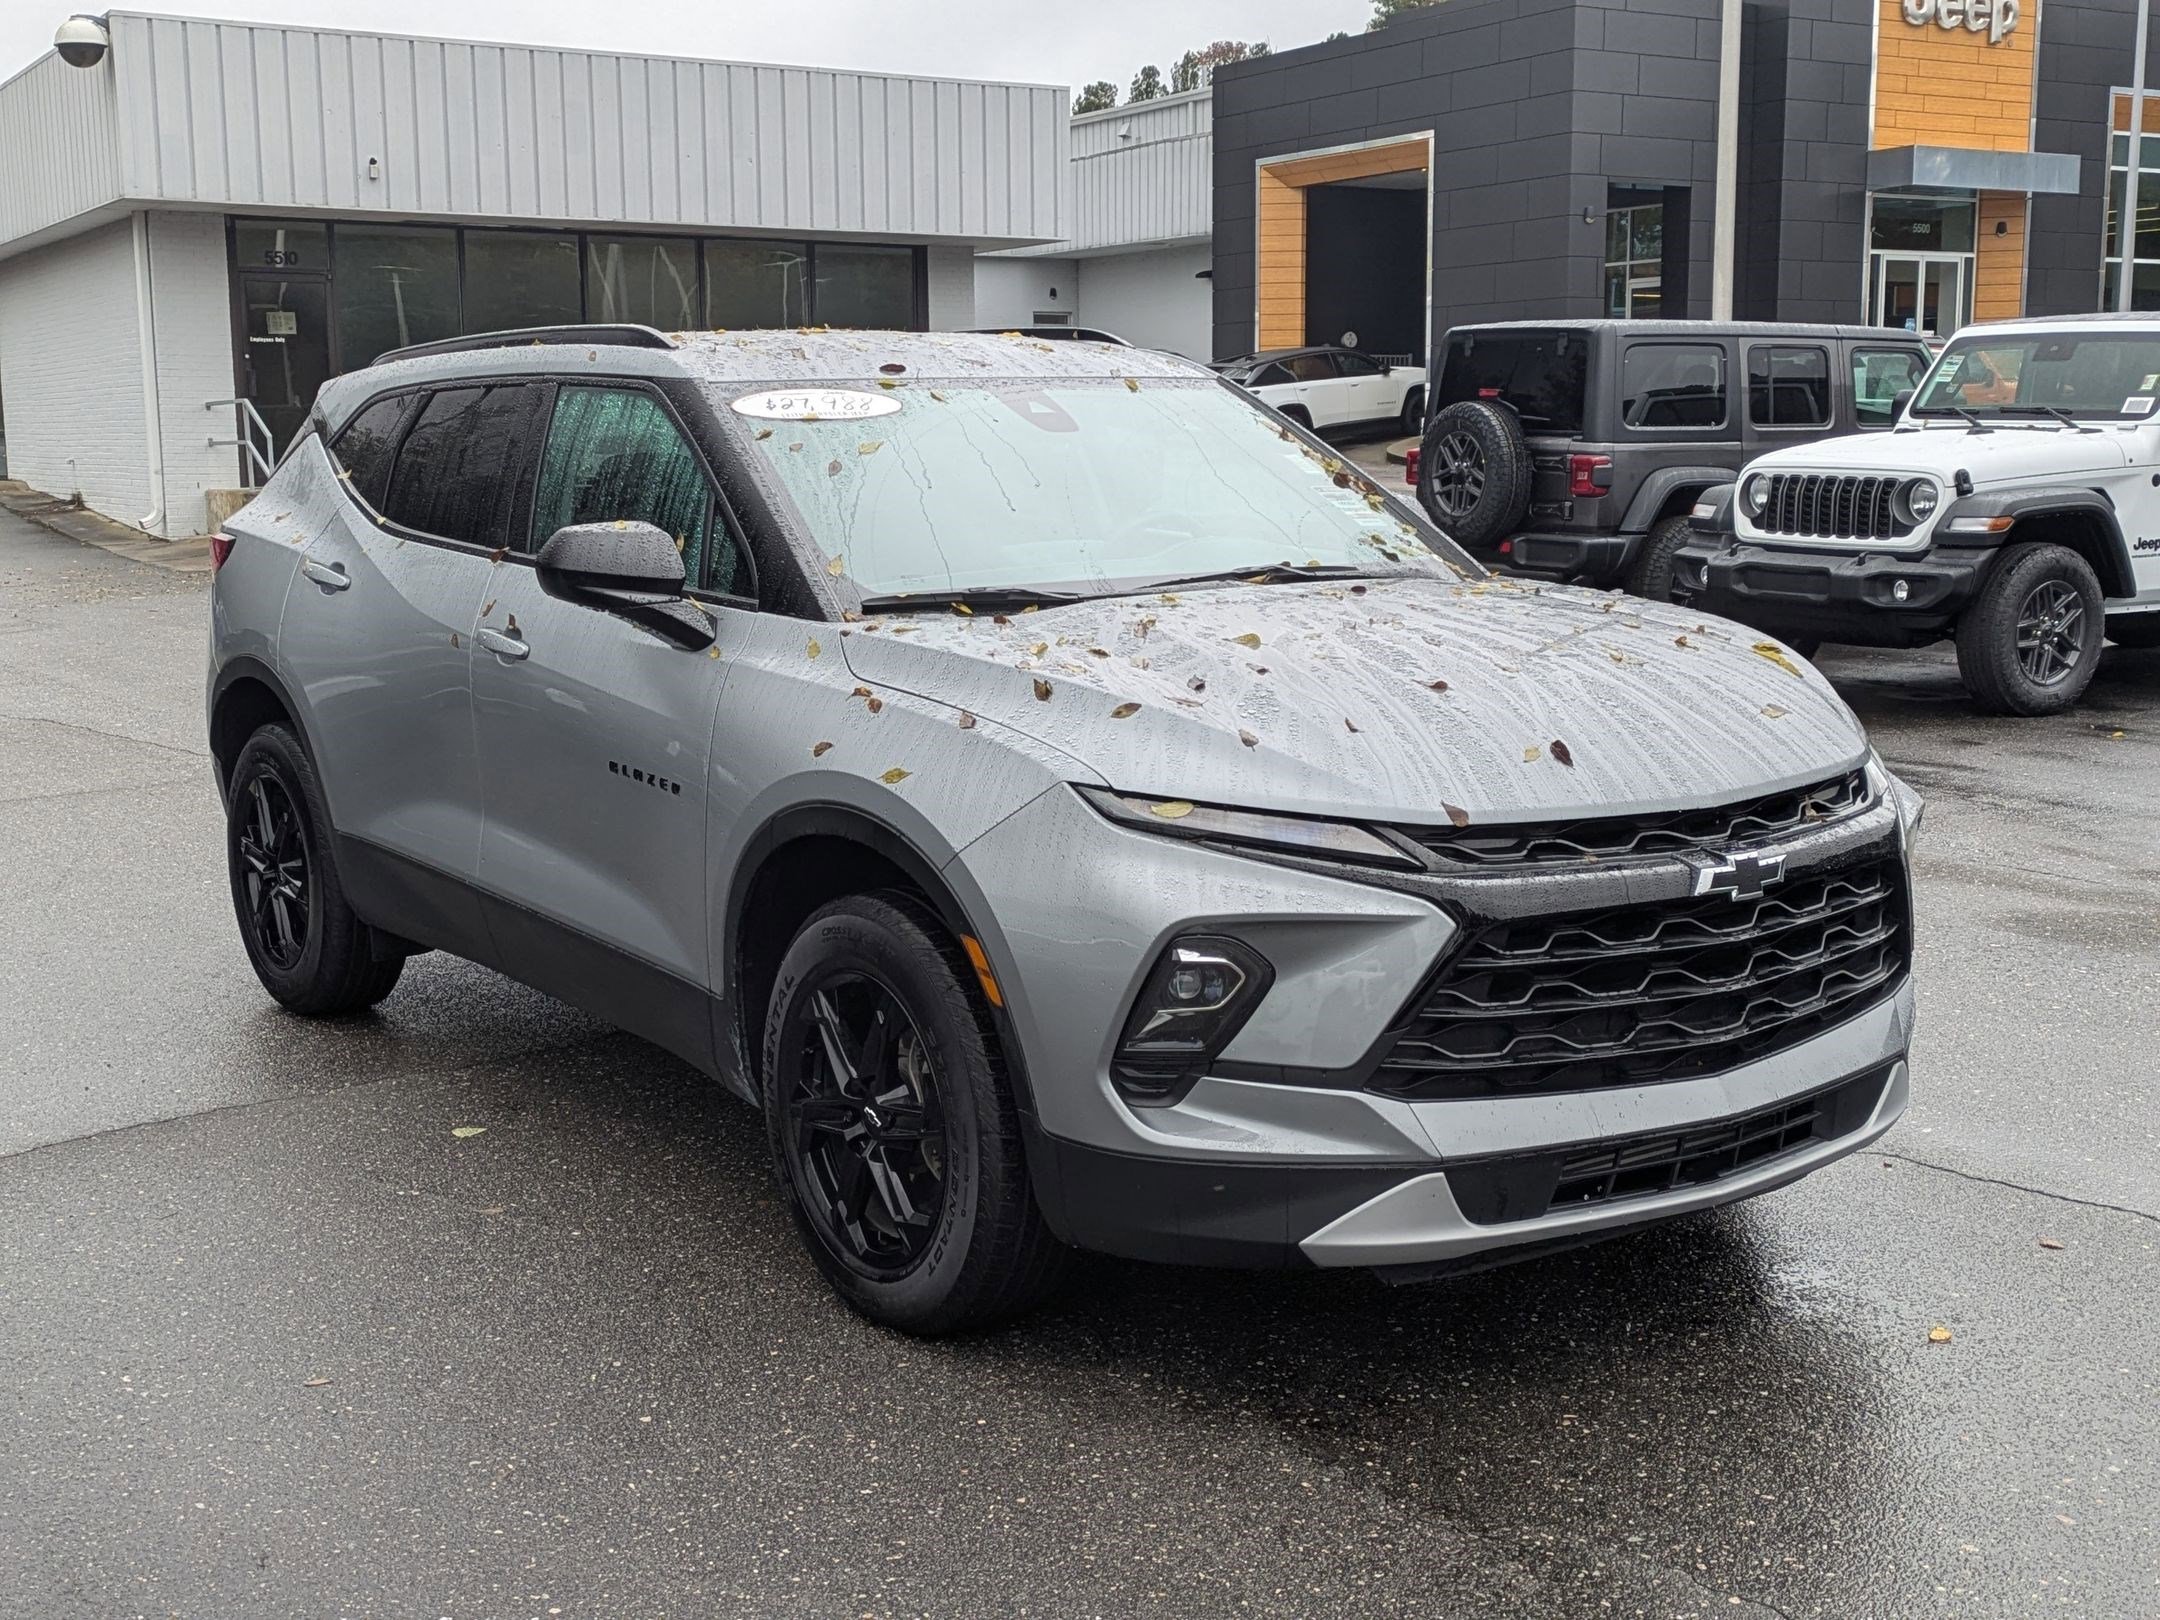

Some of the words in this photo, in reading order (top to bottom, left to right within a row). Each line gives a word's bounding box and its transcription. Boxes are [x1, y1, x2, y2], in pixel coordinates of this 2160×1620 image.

[1912, 223, 1931, 234] 5500
[265, 251, 298, 265] 5510
[766, 397, 873, 411] $27,988
[607, 760, 681, 797] BLAZER
